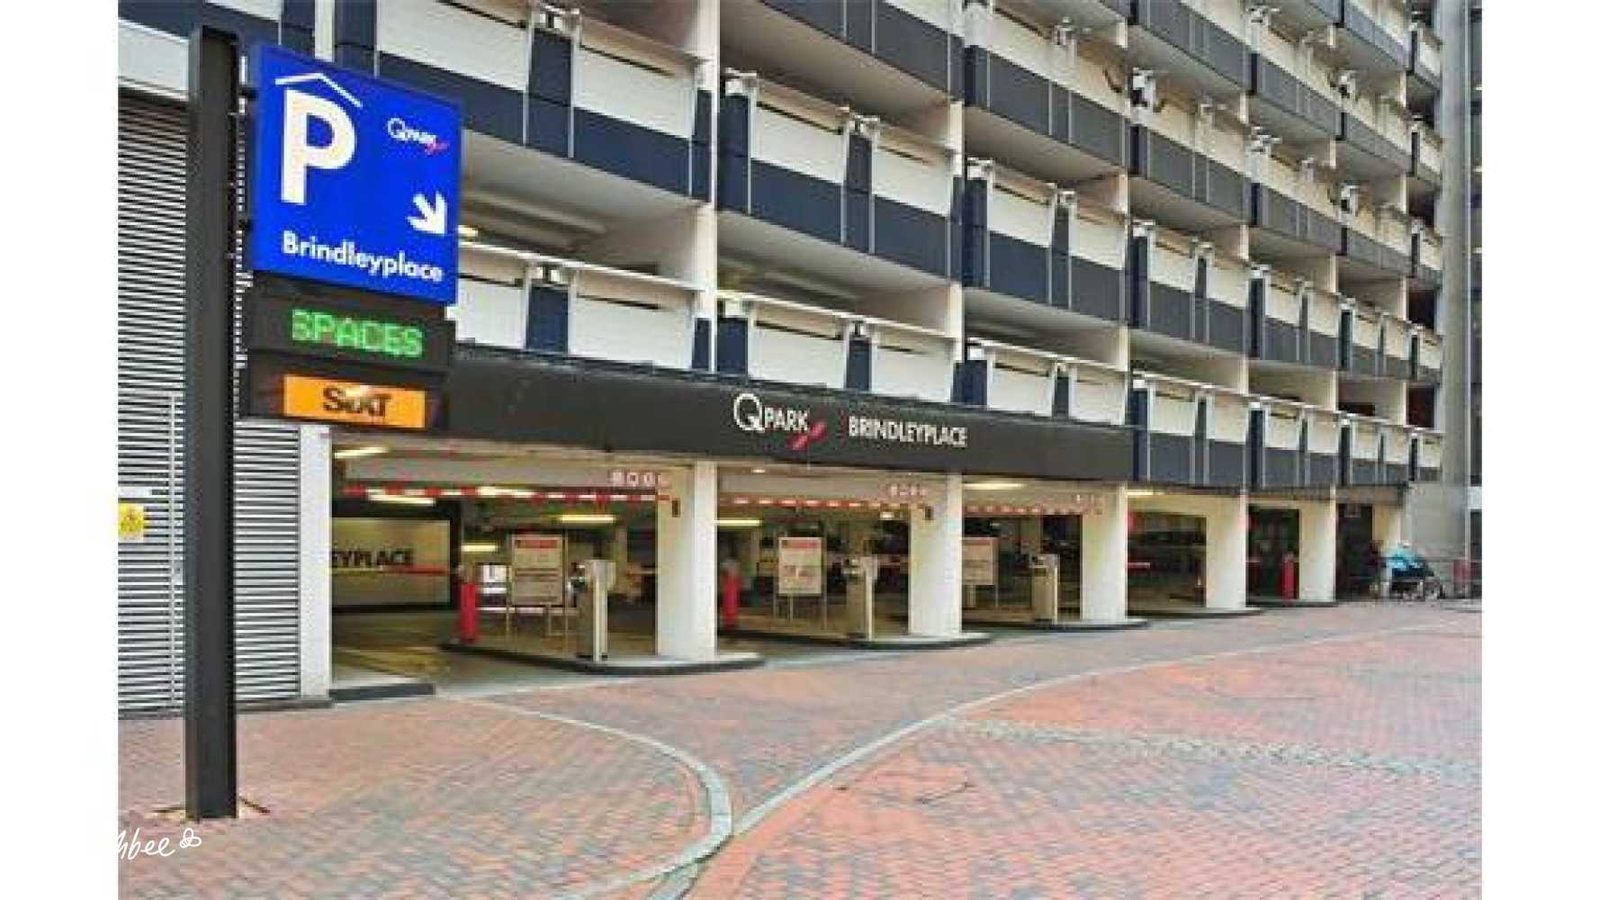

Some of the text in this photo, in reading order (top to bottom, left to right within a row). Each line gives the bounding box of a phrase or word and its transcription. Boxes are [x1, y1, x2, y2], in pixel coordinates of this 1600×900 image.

[281, 88, 357, 205] P
[282, 230, 444, 283] Brindleyplace
[292, 309, 423, 356] SPACES
[848, 415, 968, 448] BRINDLEYPLACE
[331, 549, 414, 569] EYPLACE
